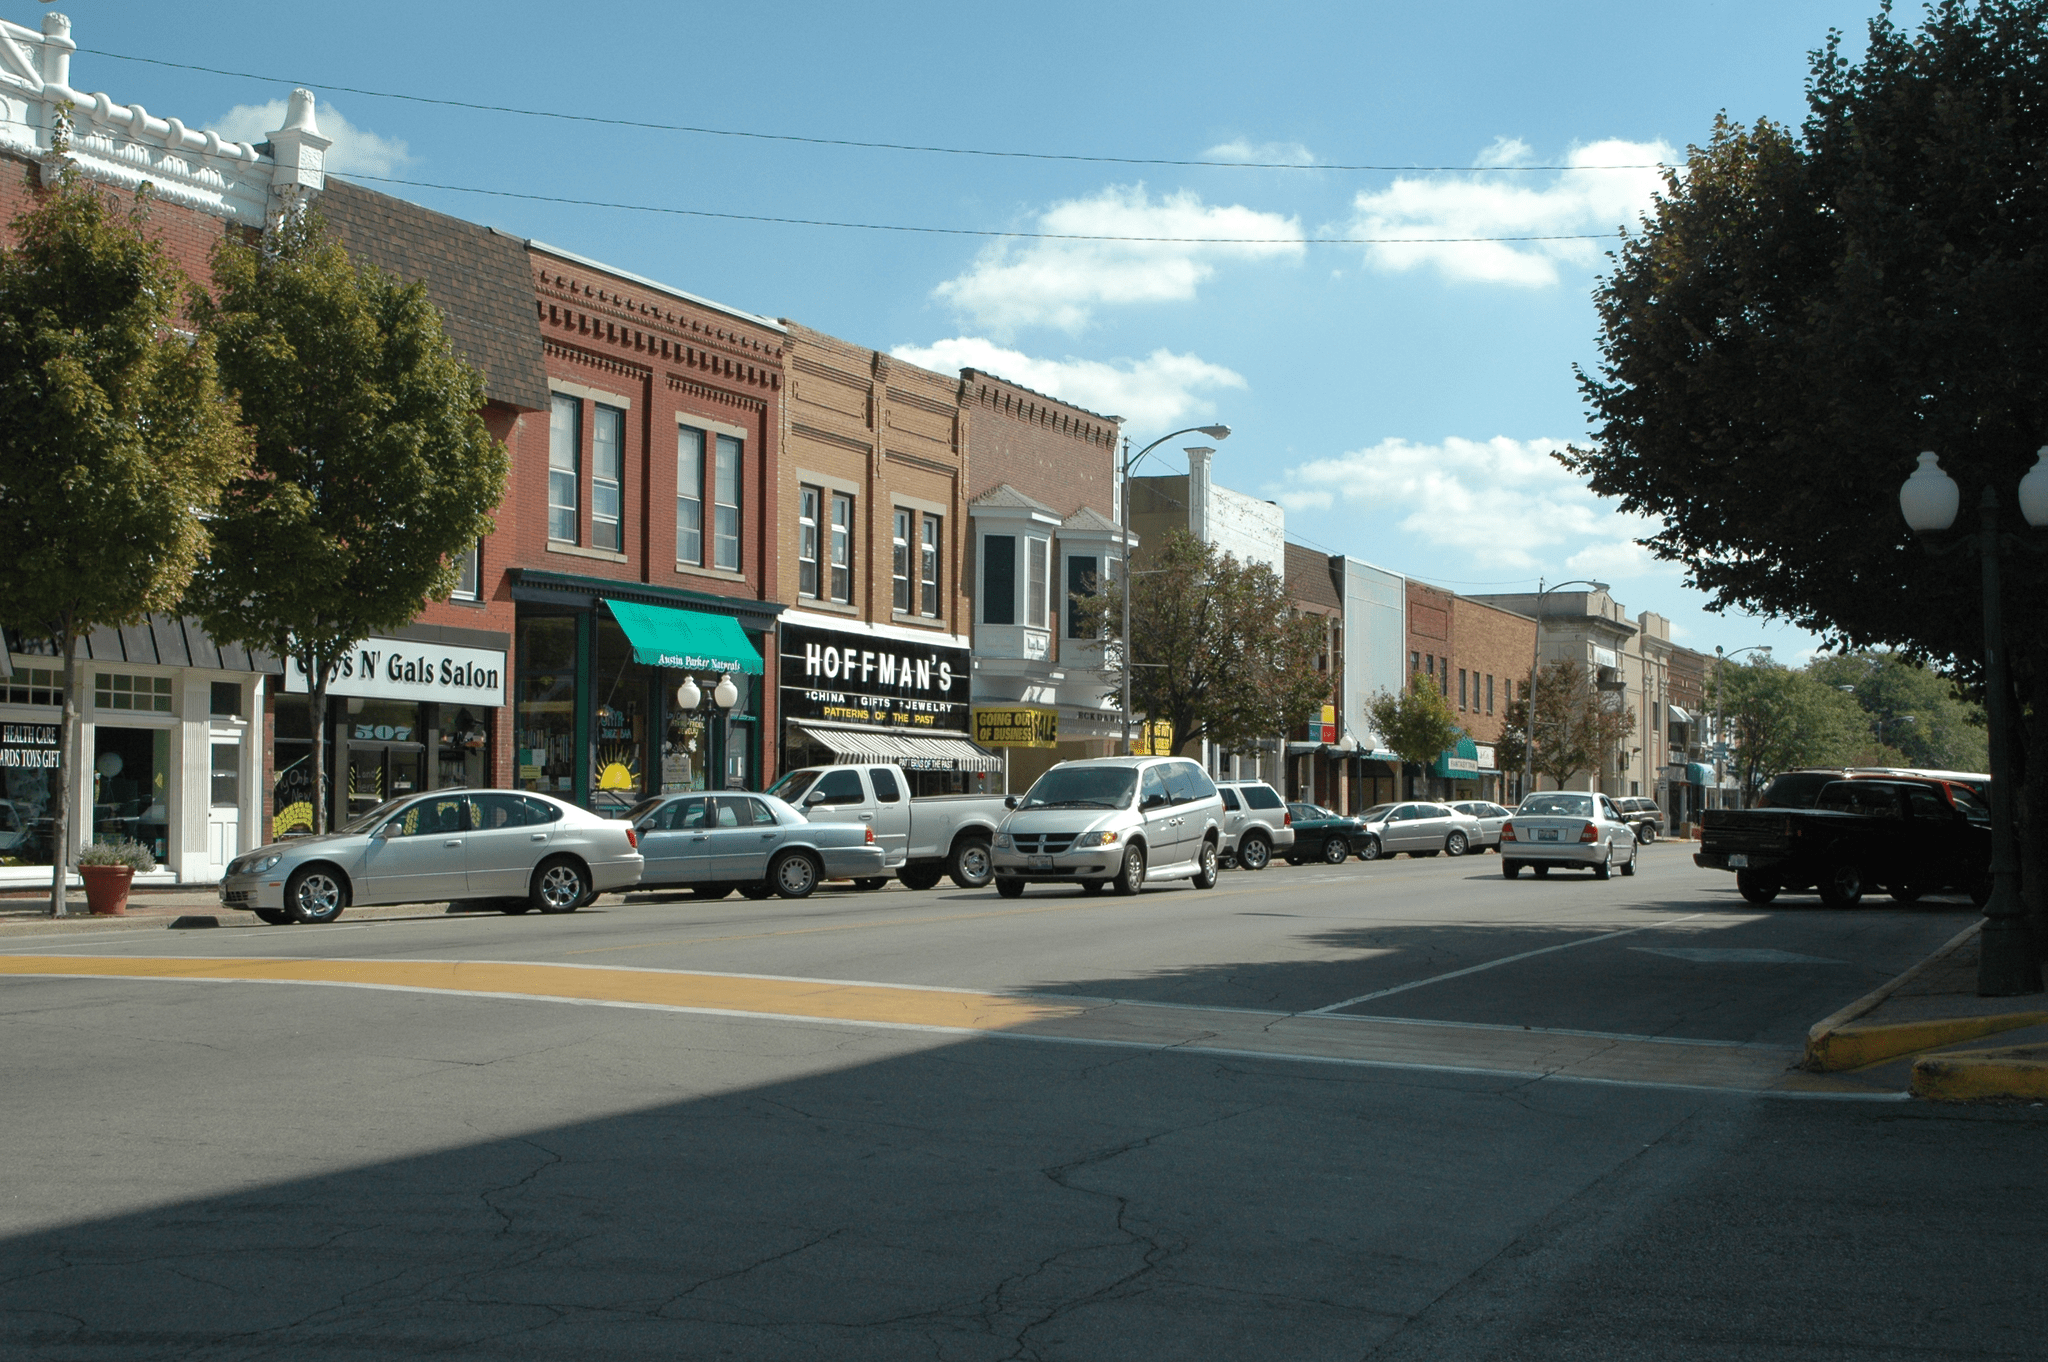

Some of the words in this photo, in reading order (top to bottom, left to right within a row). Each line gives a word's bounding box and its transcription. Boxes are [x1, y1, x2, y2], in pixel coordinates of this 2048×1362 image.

[387, 652, 434, 684] Gals
[439, 657, 499, 689] Salon
[658, 653, 683, 665] Austin
[685, 655, 710, 667] Parker
[711, 657, 741, 671] Naturals
[805, 642, 952, 692] HOFFMAN'S
[810, 691, 845, 703] CHINA
[860, 696, 891, 708] GIFTS
[905, 701, 952, 713] JEWELRY
[823, 706, 869, 720] PATTERNS
[874, 711, 886, 721] OF
[892, 712, 909, 723] THE
[914, 714, 935, 725] PAST
[979, 712, 1012, 726] GOING
[1014, 712, 1031, 726] OUT
[3, 724, 35, 744] HEALTH
[36, 725, 57, 745] CARE
[354, 723, 412, 741] 507
[979, 727, 992, 740] OF
[993, 727, 1032, 741] BUSINESS
[1033, 713, 1057, 741] SALE
[21, 749, 42, 768] TOYS
[898, 757, 924, 769] PATTERNS
[924, 758, 932, 769] OF
[932, 759, 941, 769] THE
[941, 760, 953, 770] PAST
